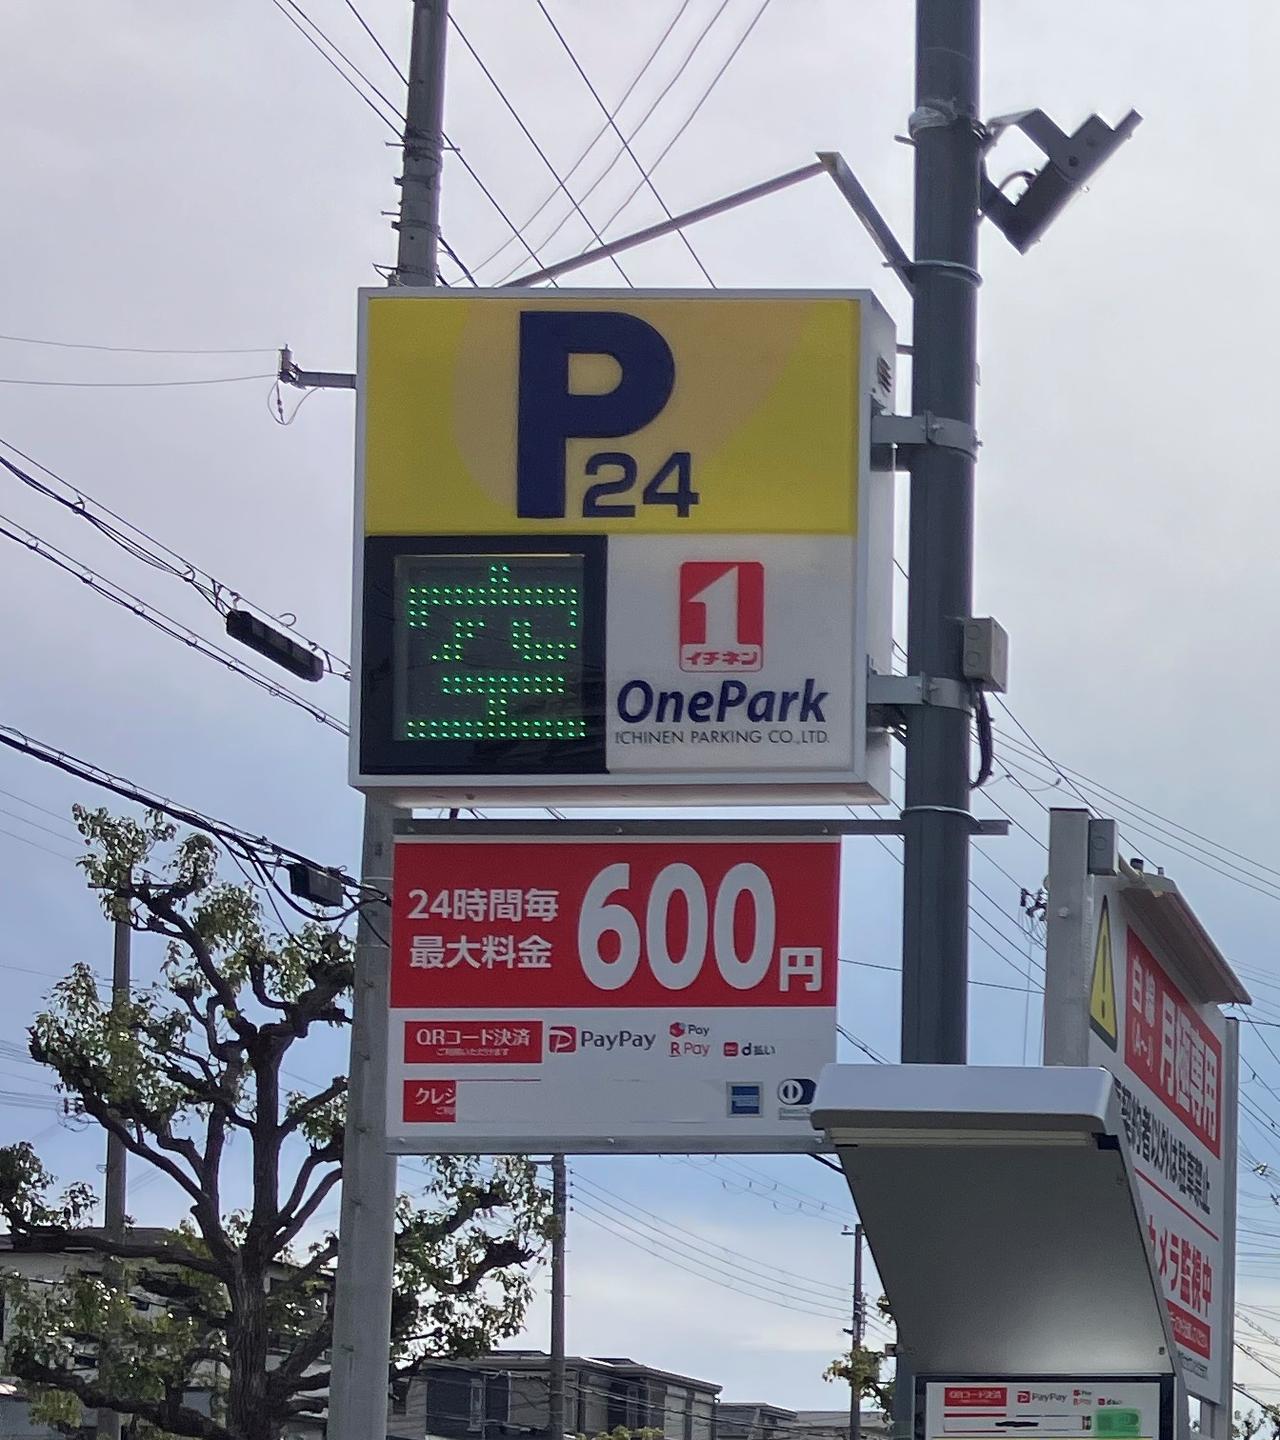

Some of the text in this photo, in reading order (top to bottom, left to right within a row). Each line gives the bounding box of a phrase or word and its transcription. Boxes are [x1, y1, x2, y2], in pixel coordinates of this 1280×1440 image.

[516, 311, 676, 519] P
[408, 563, 586, 740] 空
[684, 651, 758, 666] イチネン
[616, 678, 829, 724] OnePark
[615, 730, 685, 745] ICHINEN
[691, 730, 762, 745] PARKING
[407, 888, 560, 922] 24時間毎
[409, 935, 553, 970] 最大料金
[415, 1028, 656, 1051] QRコード決済 PayPay
[688, 1023, 710, 1037] Pay
[684, 1041, 711, 1057] Pay
